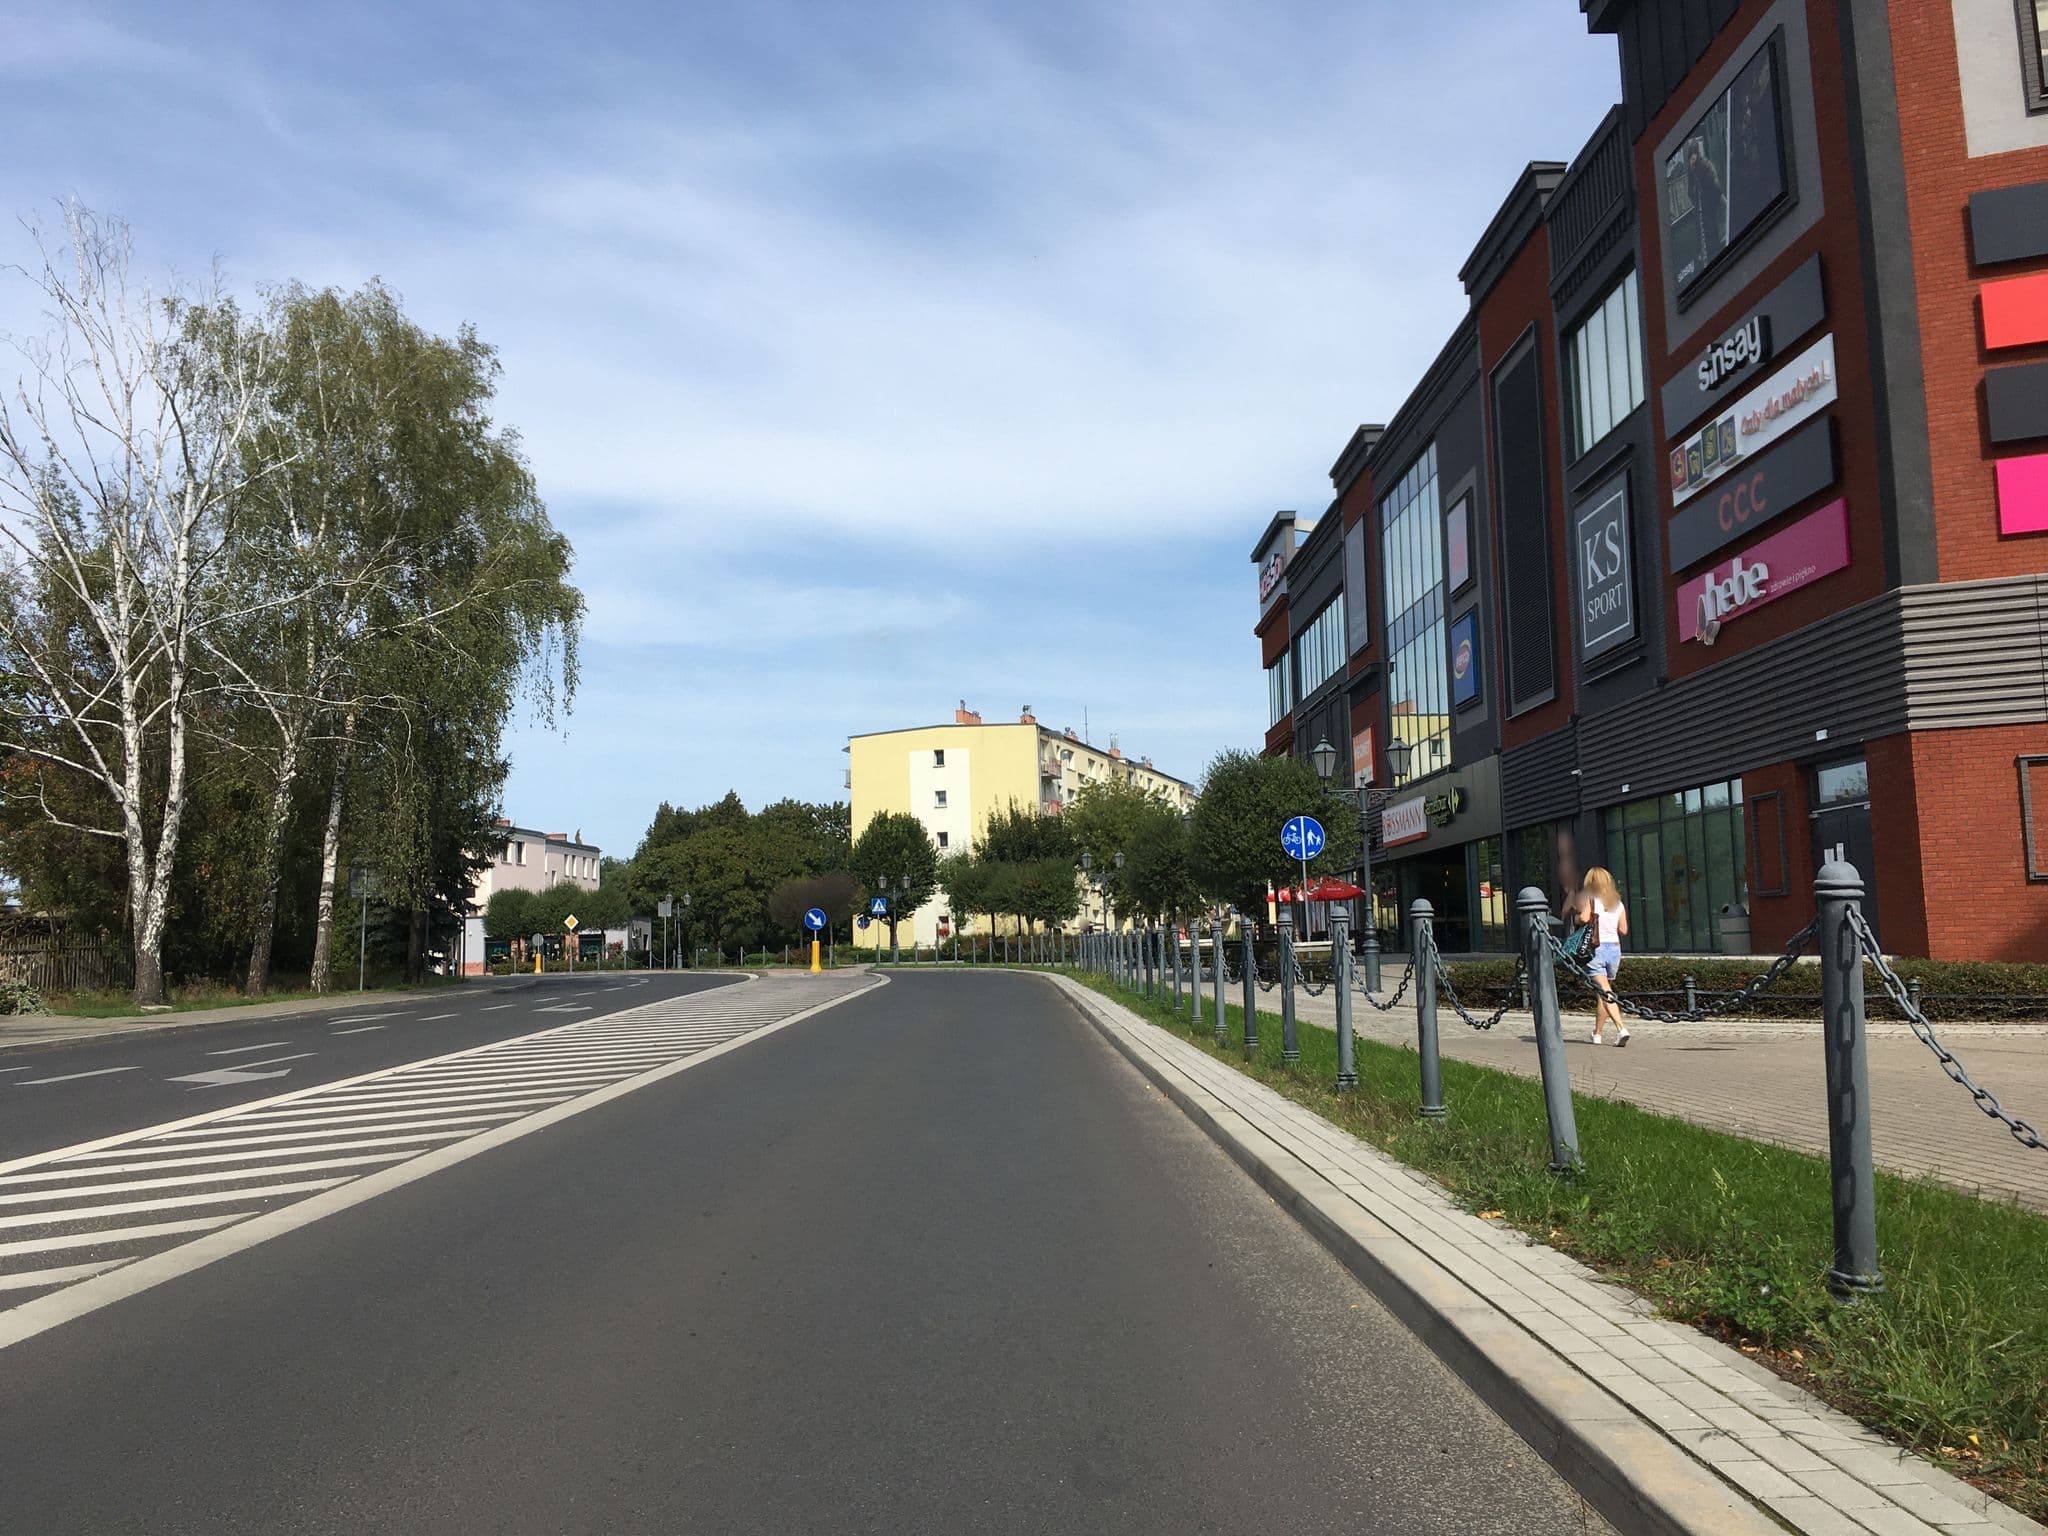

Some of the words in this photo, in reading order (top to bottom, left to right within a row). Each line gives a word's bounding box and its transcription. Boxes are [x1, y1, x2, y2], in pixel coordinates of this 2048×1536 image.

[1698, 316, 1762, 391] sinsay
[1718, 472, 1766, 531] CCC
[1584, 517, 1621, 590] KS
[1587, 583, 1623, 623] SPORT
[1703, 557, 1769, 622] hebe
